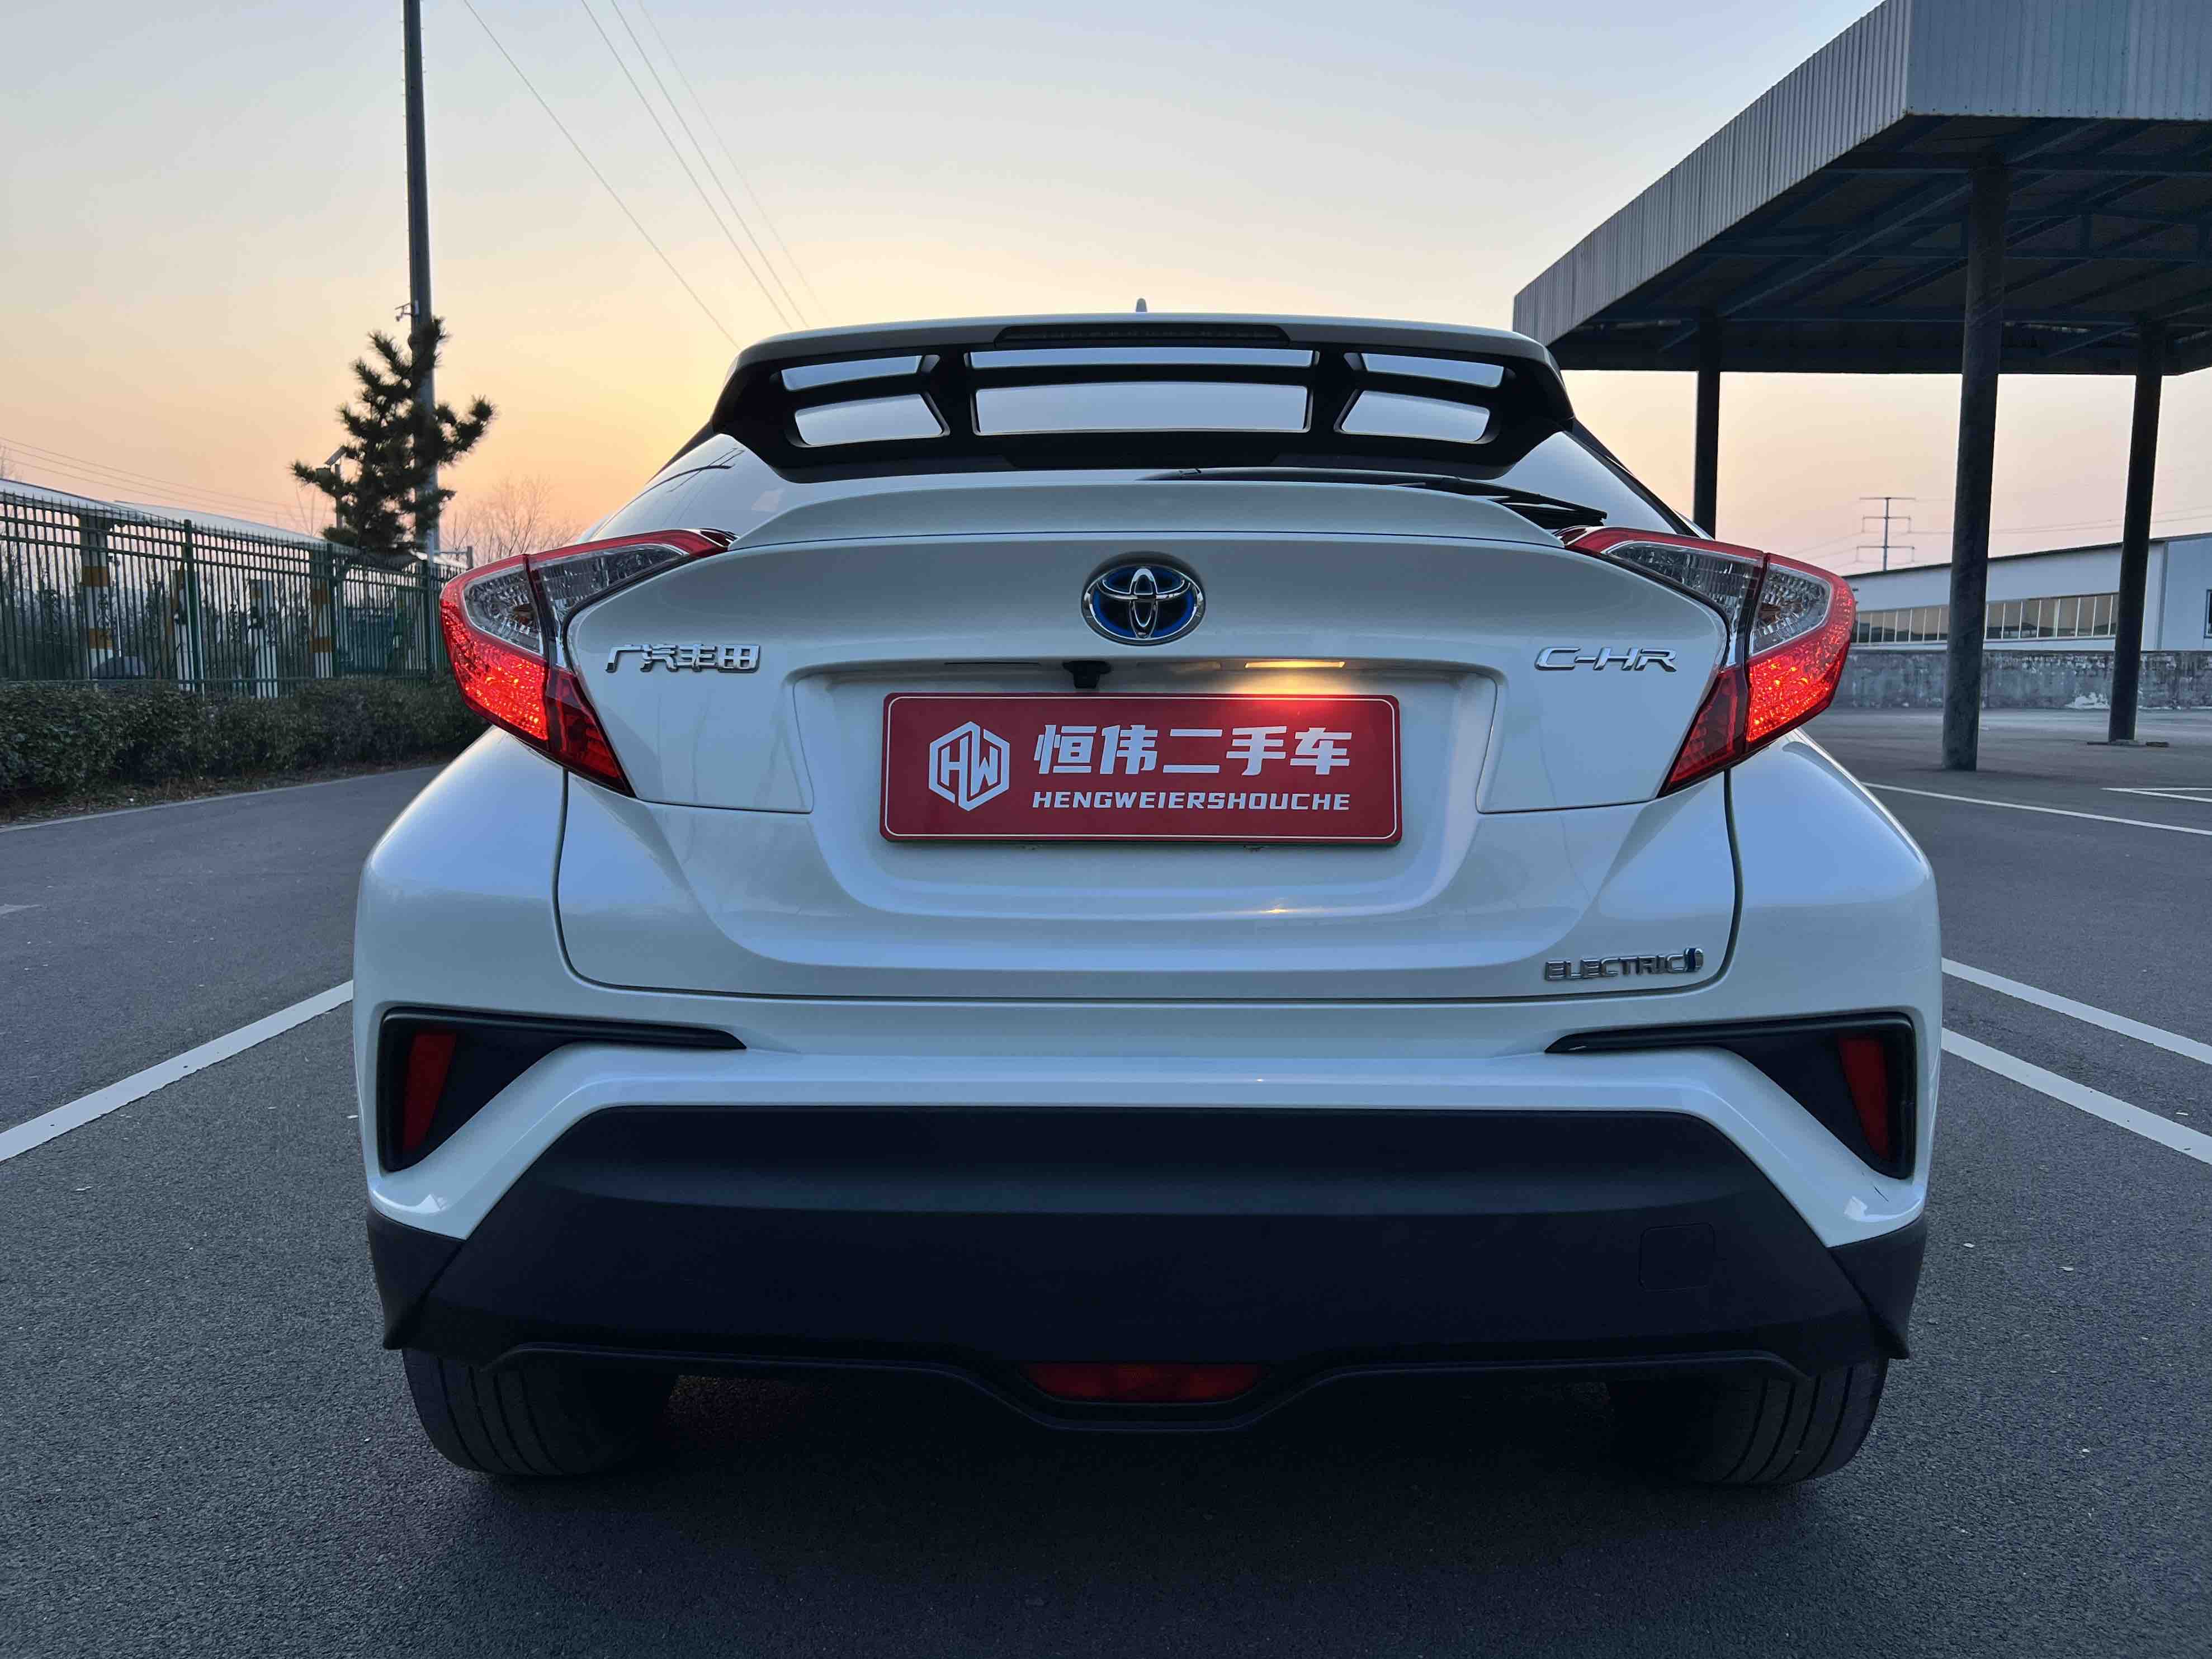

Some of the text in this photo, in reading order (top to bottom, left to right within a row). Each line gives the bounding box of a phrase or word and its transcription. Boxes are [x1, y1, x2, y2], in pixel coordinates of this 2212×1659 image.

[605, 644, 760, 673] 广汽丰田
[1535, 646, 1677, 672] C-HR
[1034, 724, 1352, 776] 恒伟二手车
[1032, 791, 1350, 810] HENGWEIERSHOUCHE
[1545, 953, 1687, 979] ELECTRIC
